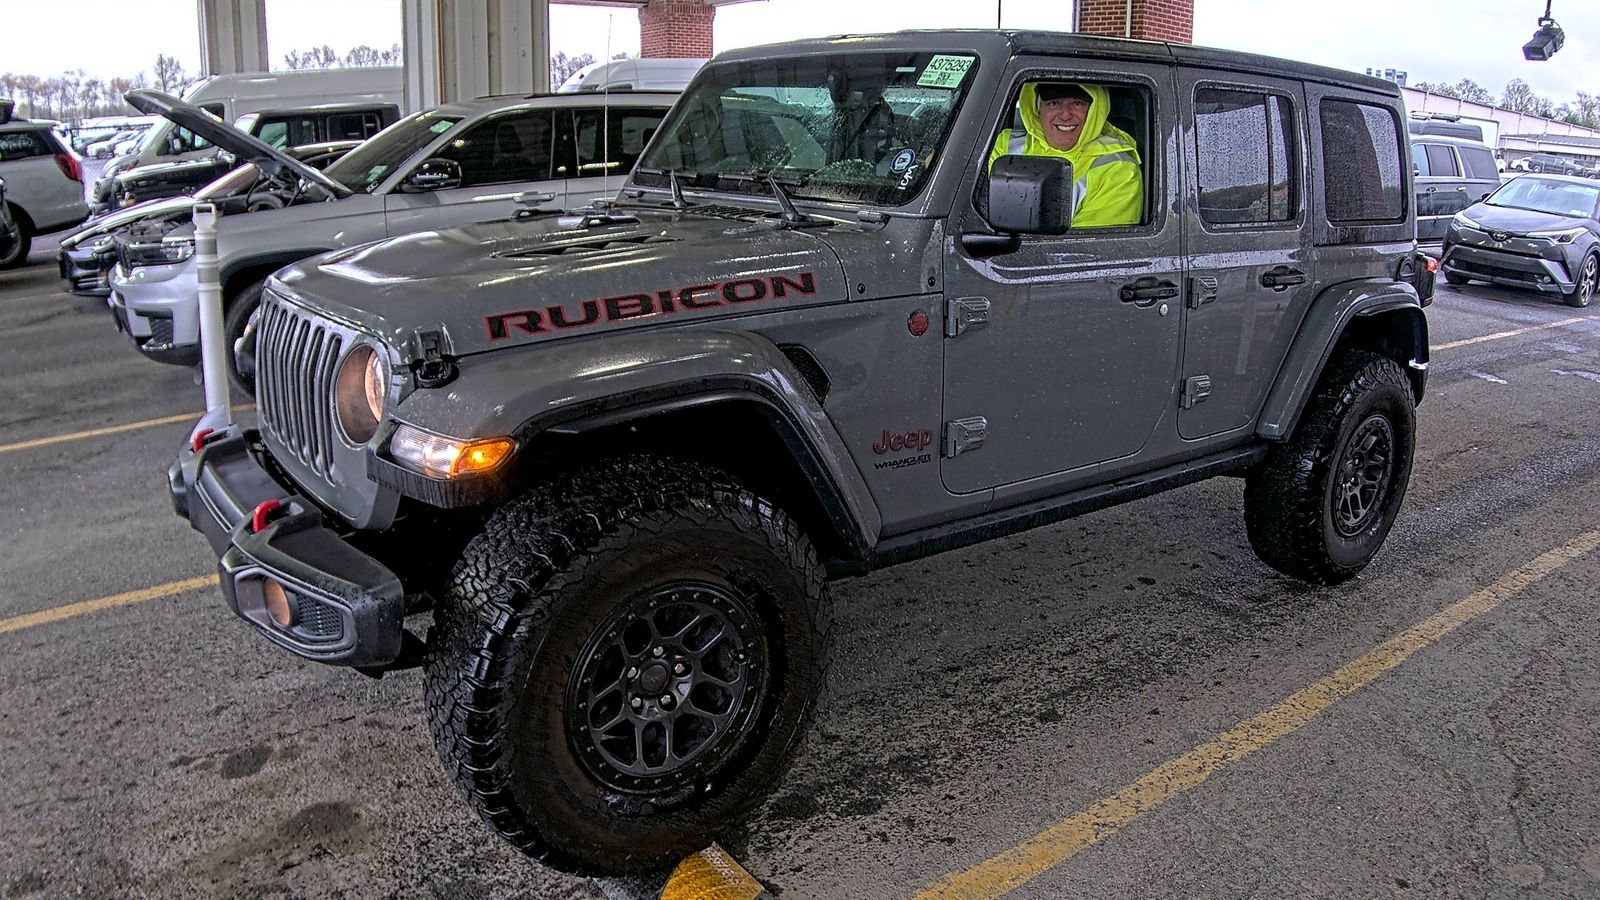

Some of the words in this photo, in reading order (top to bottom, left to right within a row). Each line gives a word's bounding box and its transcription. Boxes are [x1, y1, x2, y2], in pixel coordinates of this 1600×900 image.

[929, 58, 972, 72] 4375293
[485, 271, 817, 342] RUBICON
[872, 428, 932, 455] Jeep
[873, 453, 931, 470] WRANGLER
